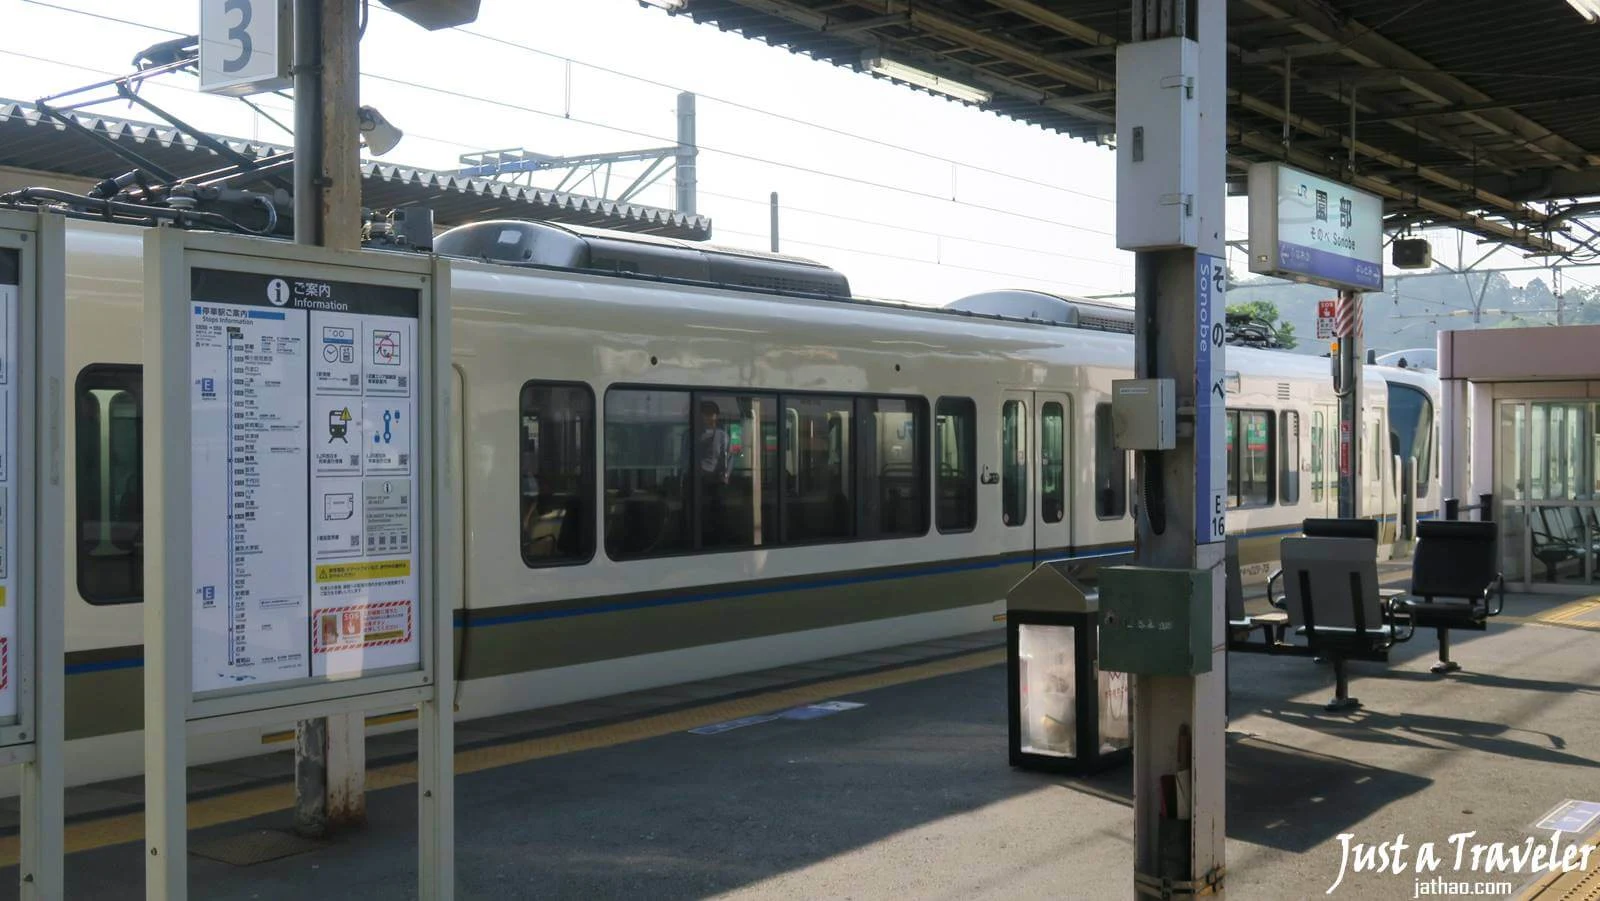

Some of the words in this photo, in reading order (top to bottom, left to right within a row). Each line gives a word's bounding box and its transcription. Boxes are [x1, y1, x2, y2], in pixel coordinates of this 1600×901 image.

[223, 0, 252, 72] 3
[1315, 189, 1352, 230] 園部
[1310, 227, 1331, 245] そのべ
[1333, 231, 1356, 251] Sonobe
[294, 281, 331, 299] ご案内
[294, 297, 348, 312] Information
[1199, 263, 1210, 352] Sonobe
[220, 317, 254, 326] Information
[1212, 265, 1225, 400] そのべ
[1215, 495, 1222, 514] E
[1212, 517, 1225, 537] 16
